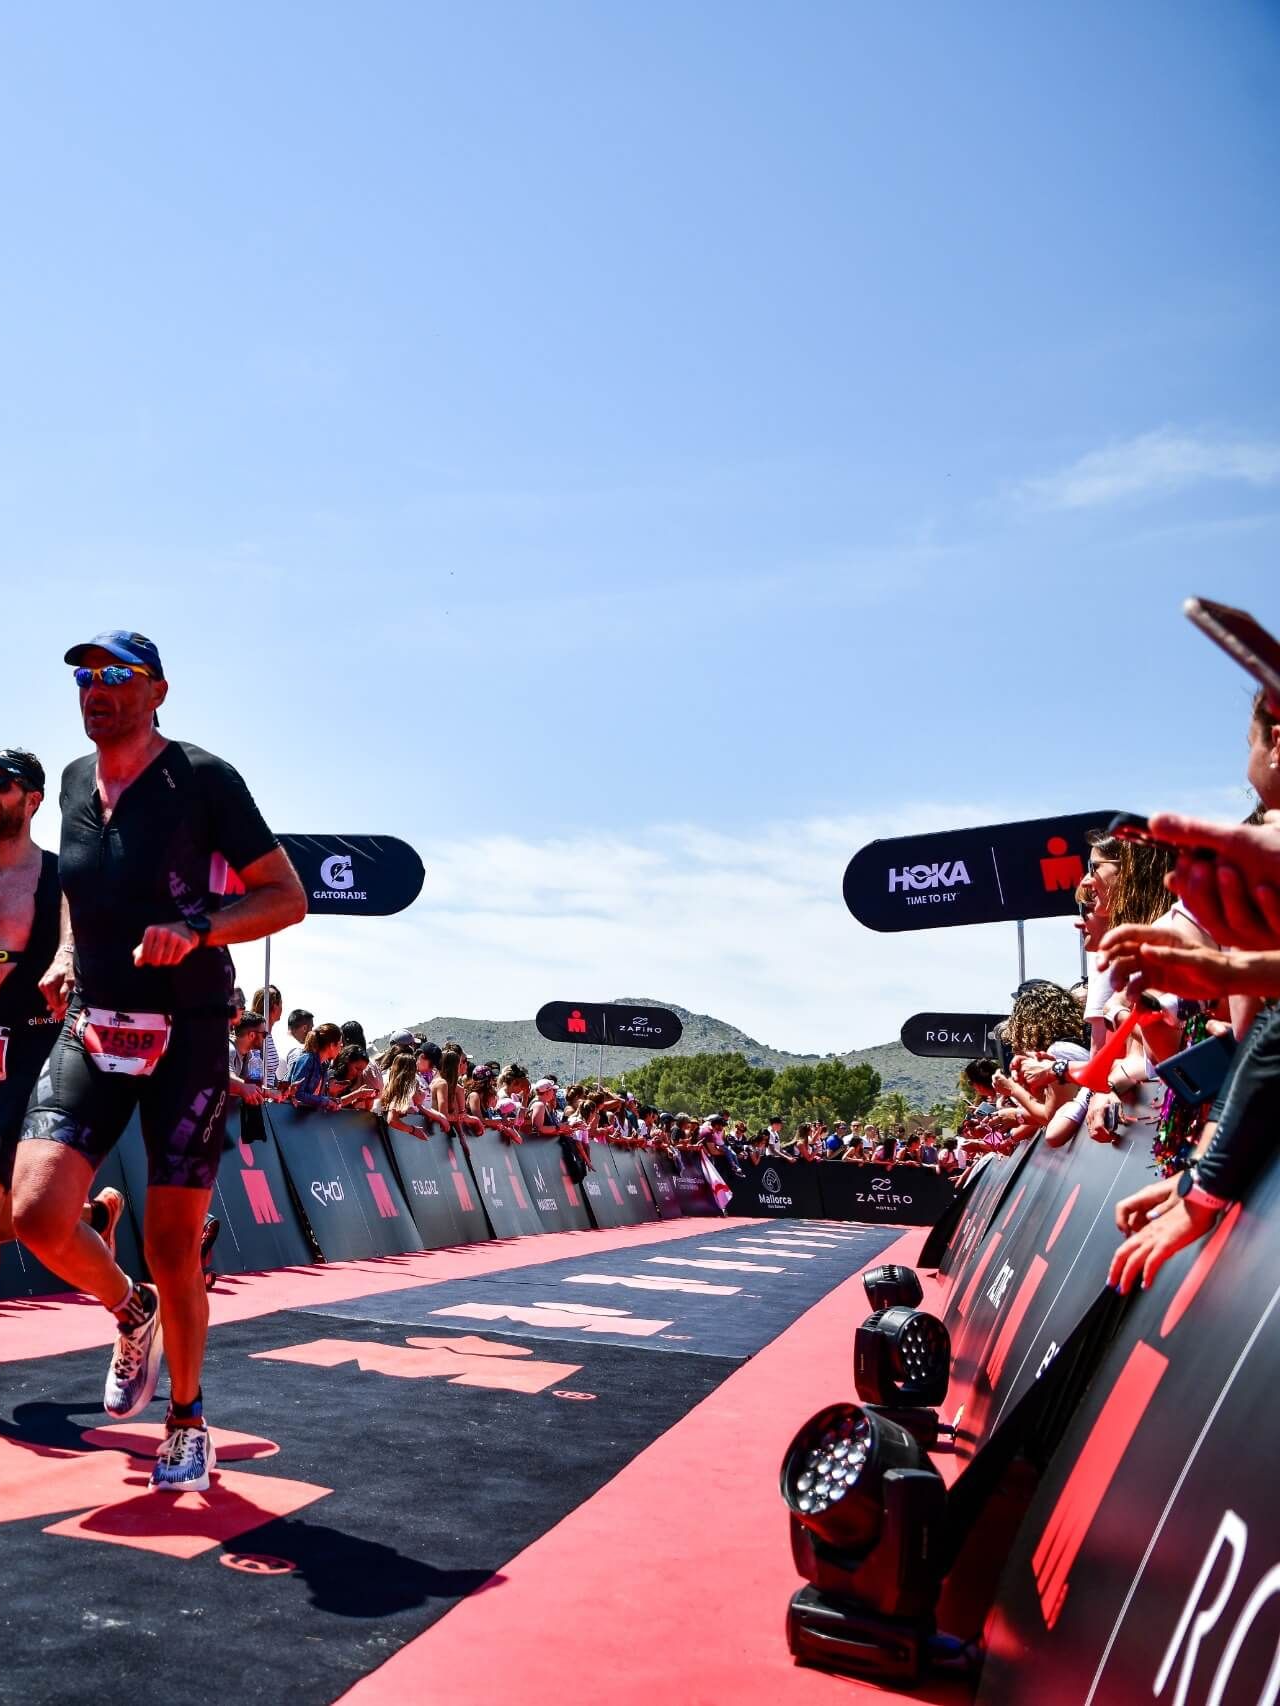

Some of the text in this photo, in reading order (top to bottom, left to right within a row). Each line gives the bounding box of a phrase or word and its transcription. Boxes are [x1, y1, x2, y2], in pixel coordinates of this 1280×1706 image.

[888, 860, 971, 892] HOKA
[312, 890, 367, 900] GATORADE
[905, 892, 957, 905] TIME TO FLY
[758, 1193, 793, 1205] Mallorca
